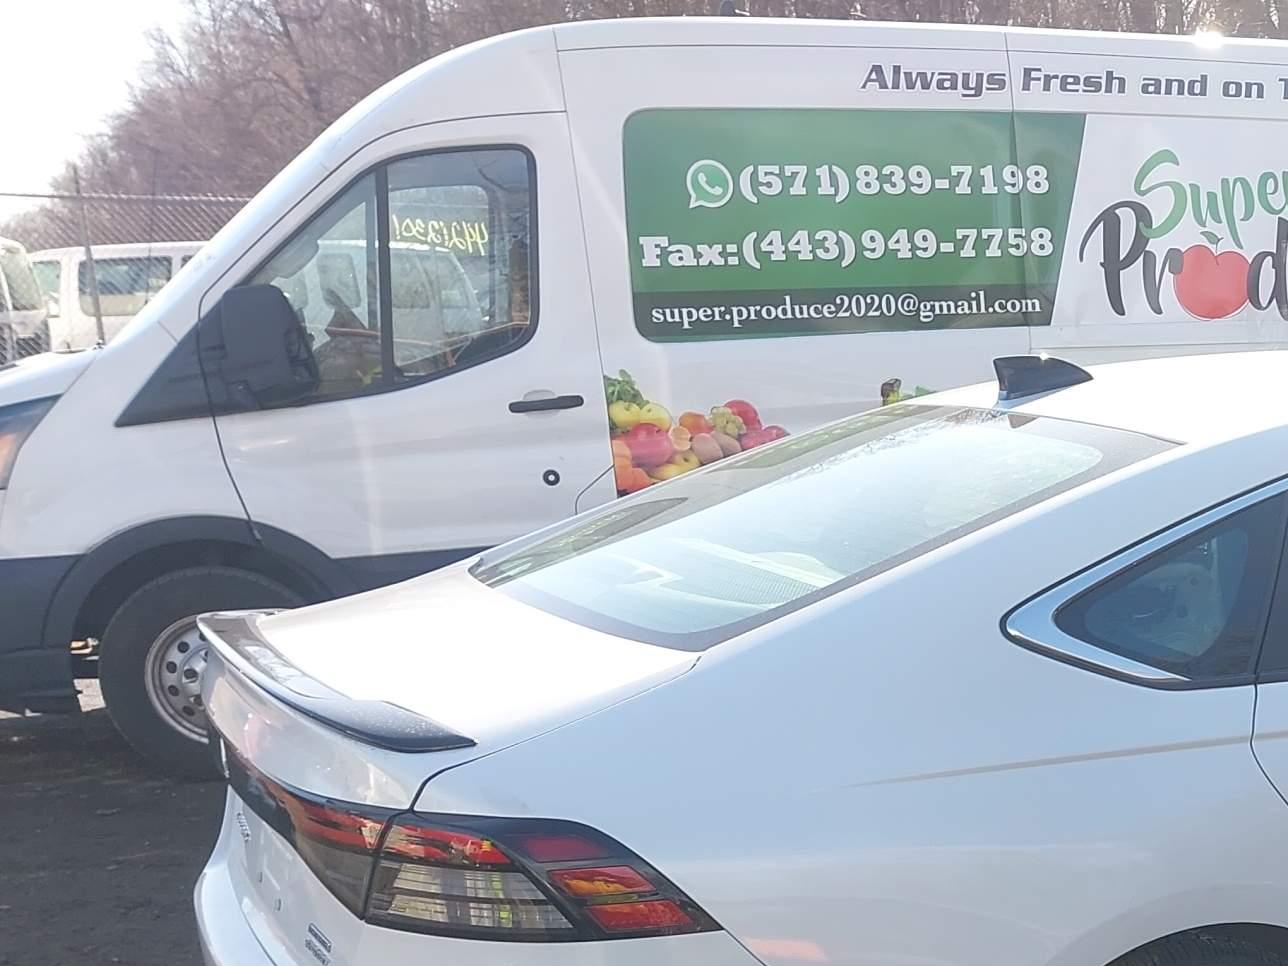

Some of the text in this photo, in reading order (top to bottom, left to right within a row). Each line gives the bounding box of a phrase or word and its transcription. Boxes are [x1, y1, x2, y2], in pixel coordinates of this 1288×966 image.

[861, 64, 1006, 98] Always
[1021, 67, 1126, 94] Fresh
[1141, 74, 1208, 97] and
[1222, 80, 1265, 99] on
[651, 290, 1042, 329] super.produce2020@gmail.com
